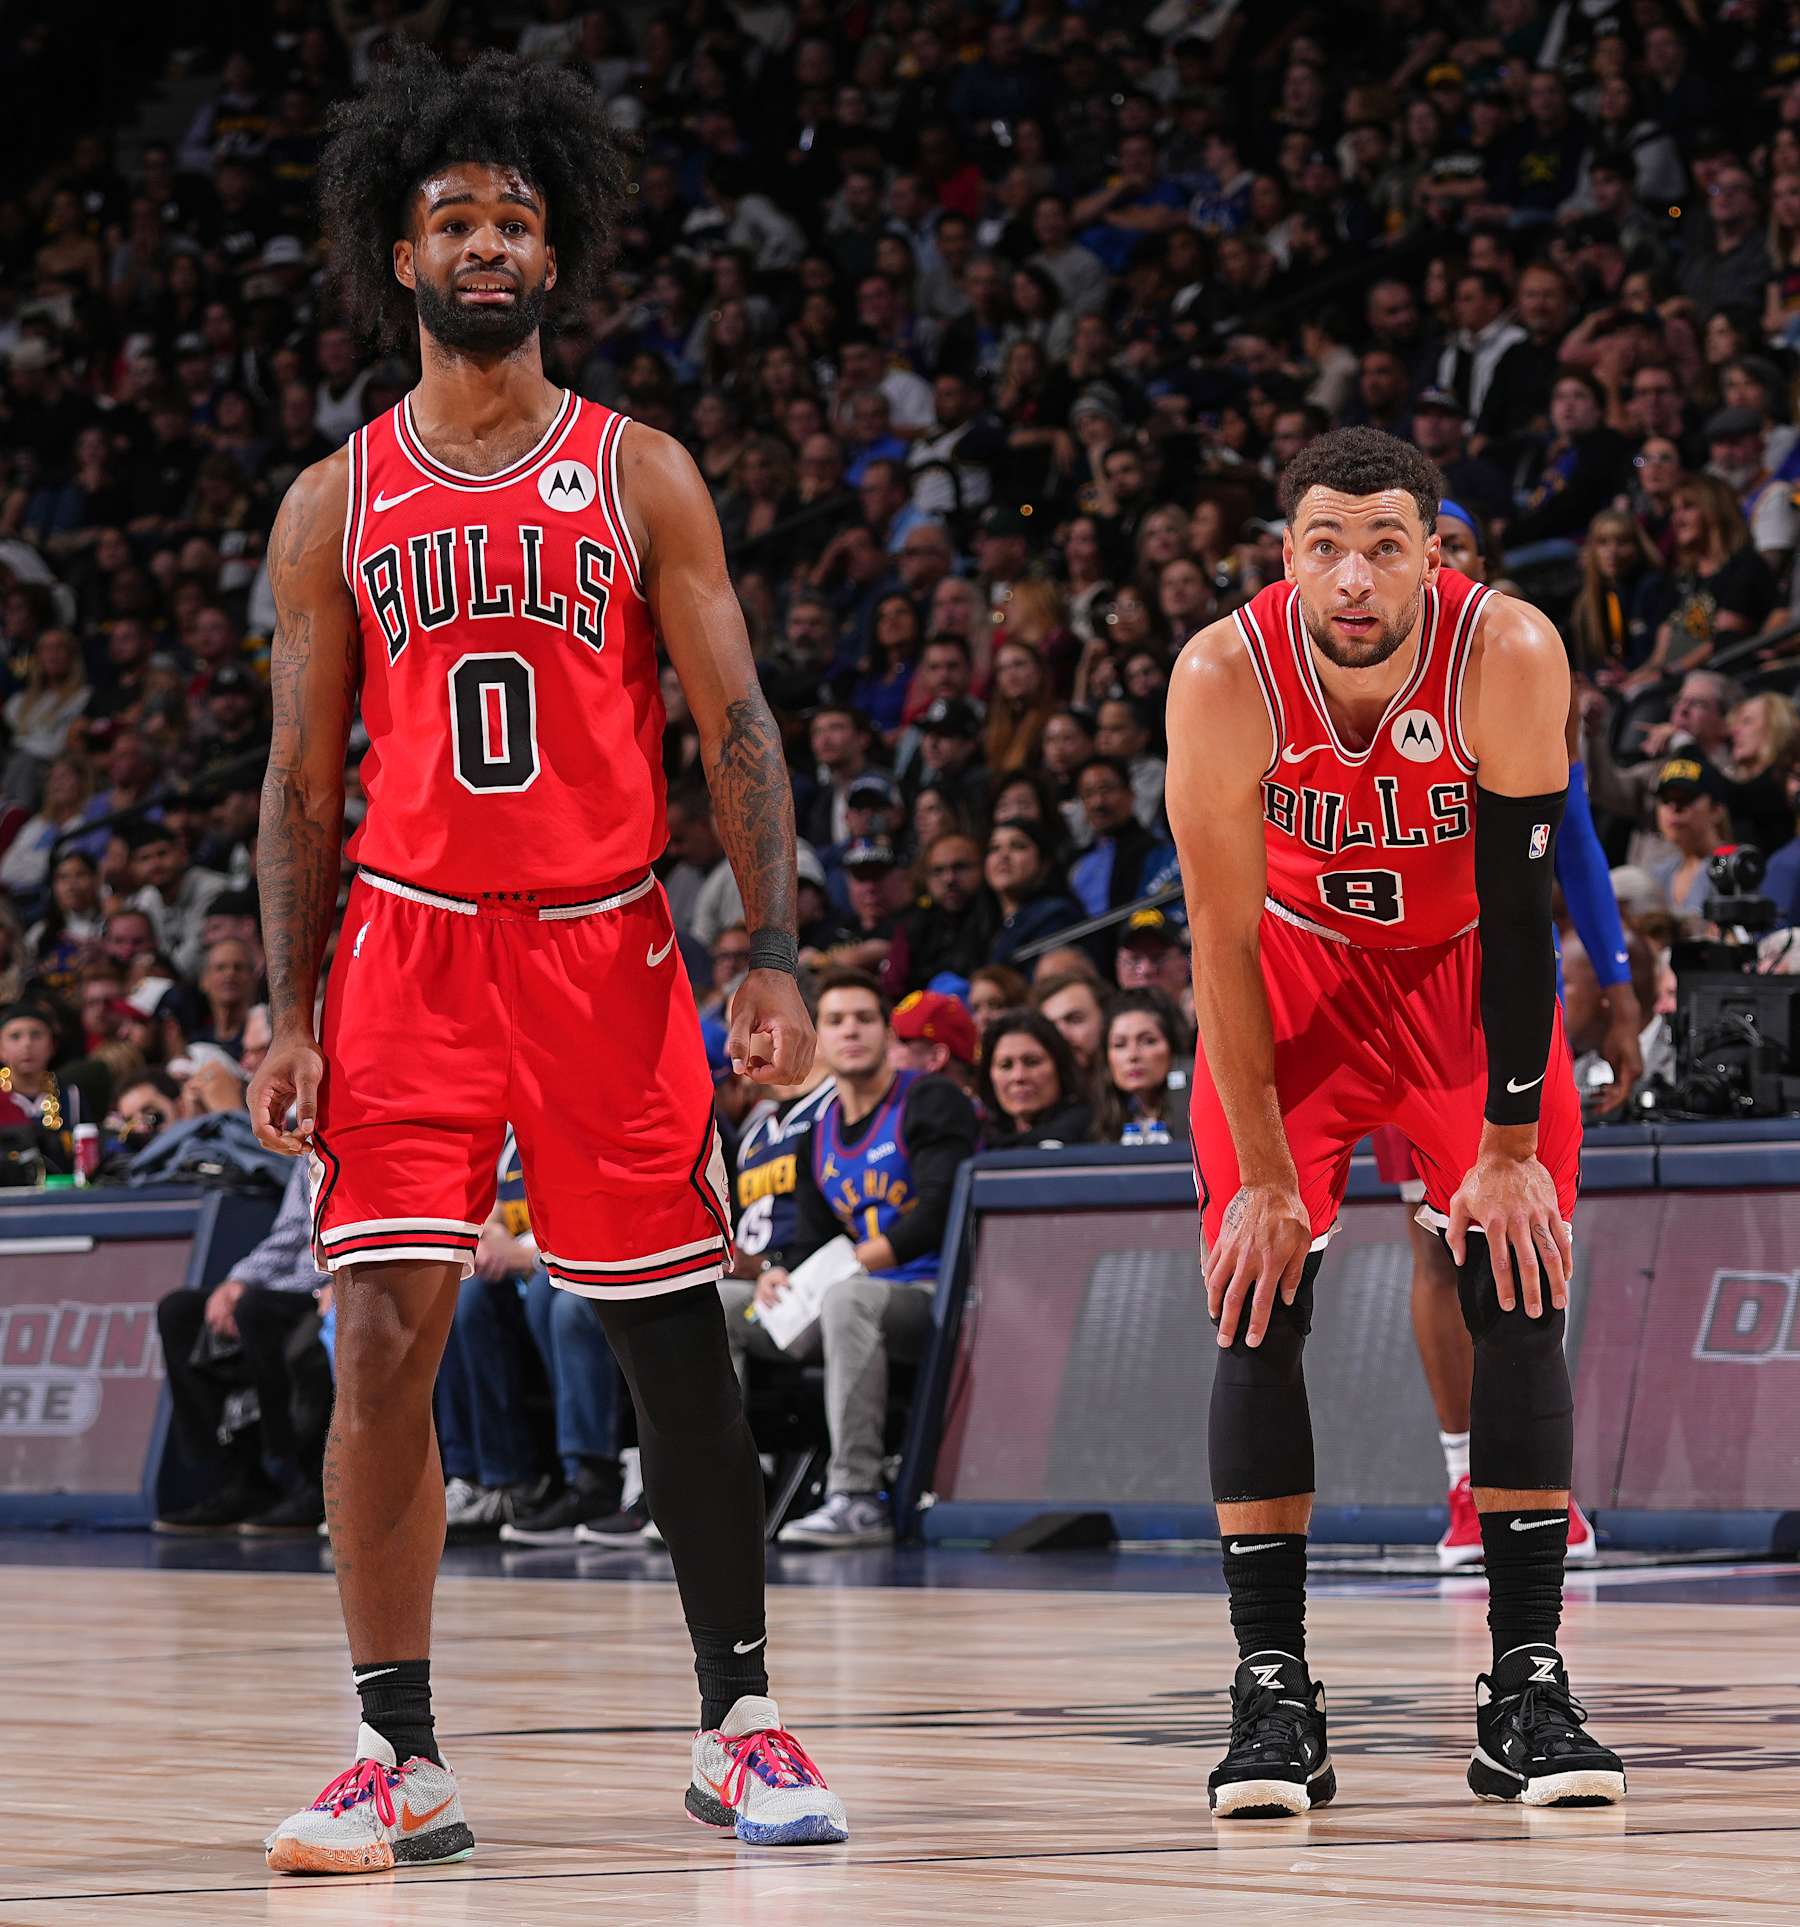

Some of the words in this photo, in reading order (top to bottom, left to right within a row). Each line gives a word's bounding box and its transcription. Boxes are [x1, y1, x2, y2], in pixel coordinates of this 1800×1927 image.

[359, 525, 615, 667] BULLS
[447, 651, 541, 795] 0
[1260, 776, 1471, 854] BULLS
[1316, 869, 1405, 926] 8
[0, 1303, 165, 1377] OUN
